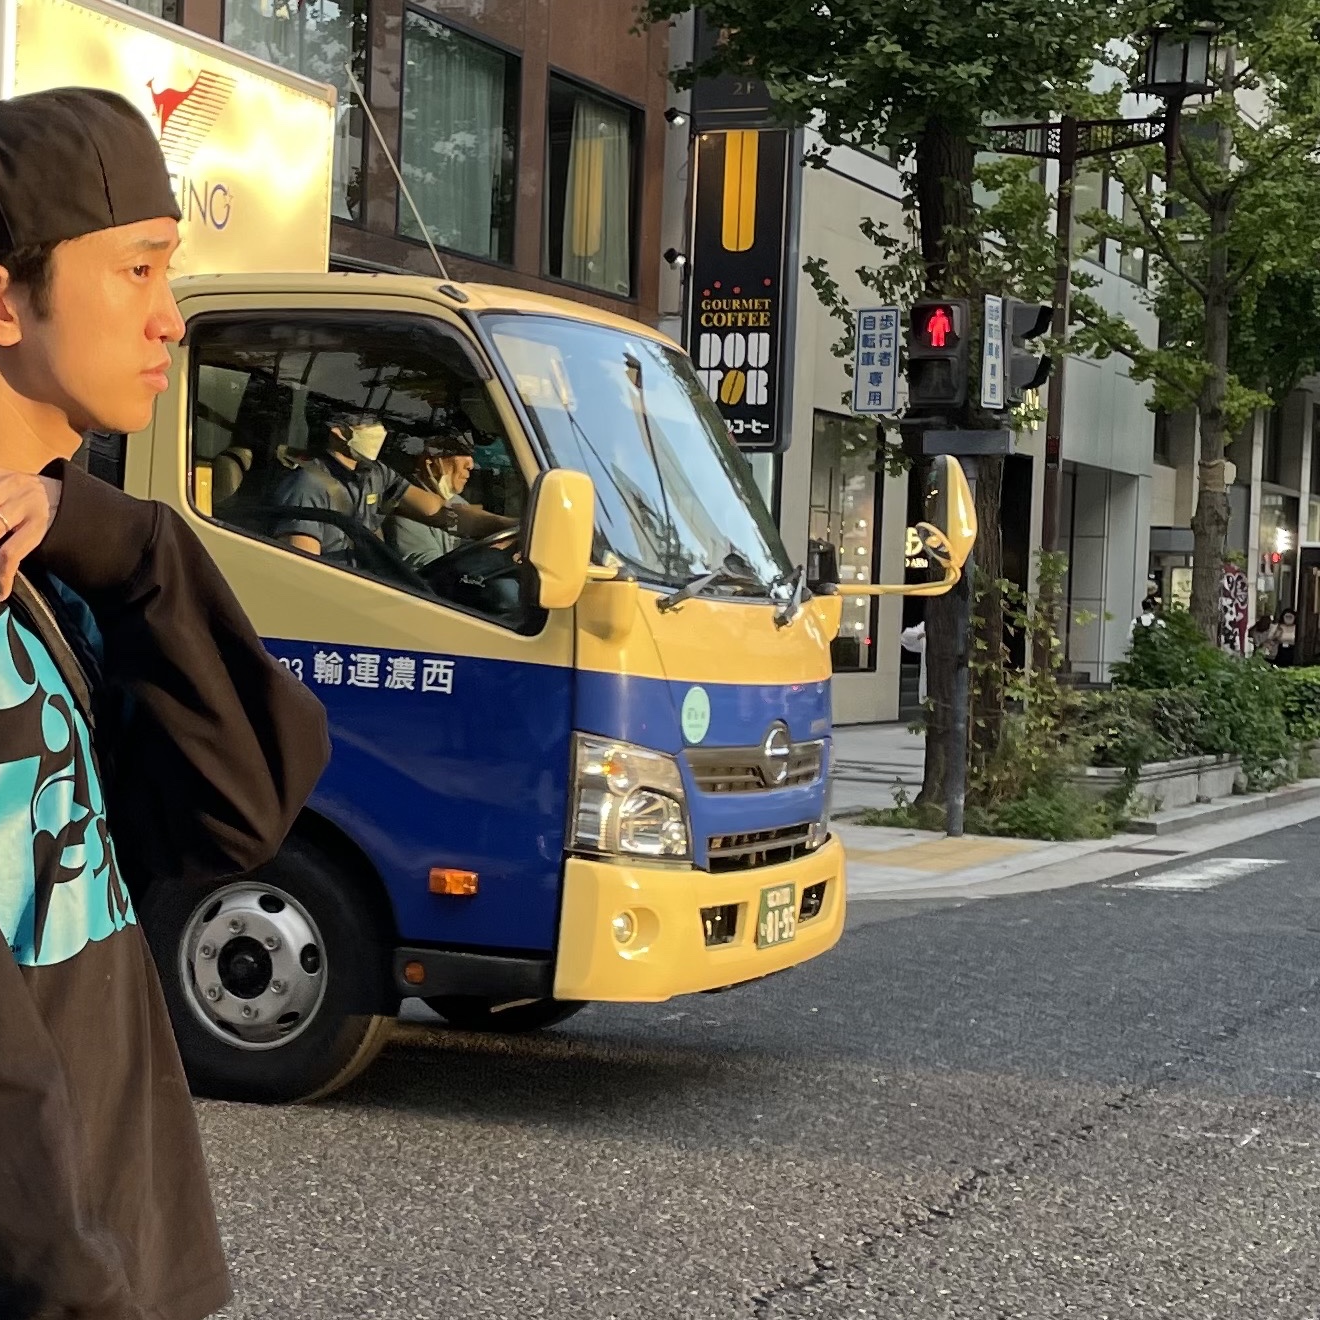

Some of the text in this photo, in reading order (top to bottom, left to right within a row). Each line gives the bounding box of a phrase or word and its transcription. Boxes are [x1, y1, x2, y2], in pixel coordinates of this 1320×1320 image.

[732, 81, 756, 95] 2F
[700, 299, 772, 311] GOURMET
[700, 311, 771, 328] COFFEE
[699, 332, 771, 369] DOU
